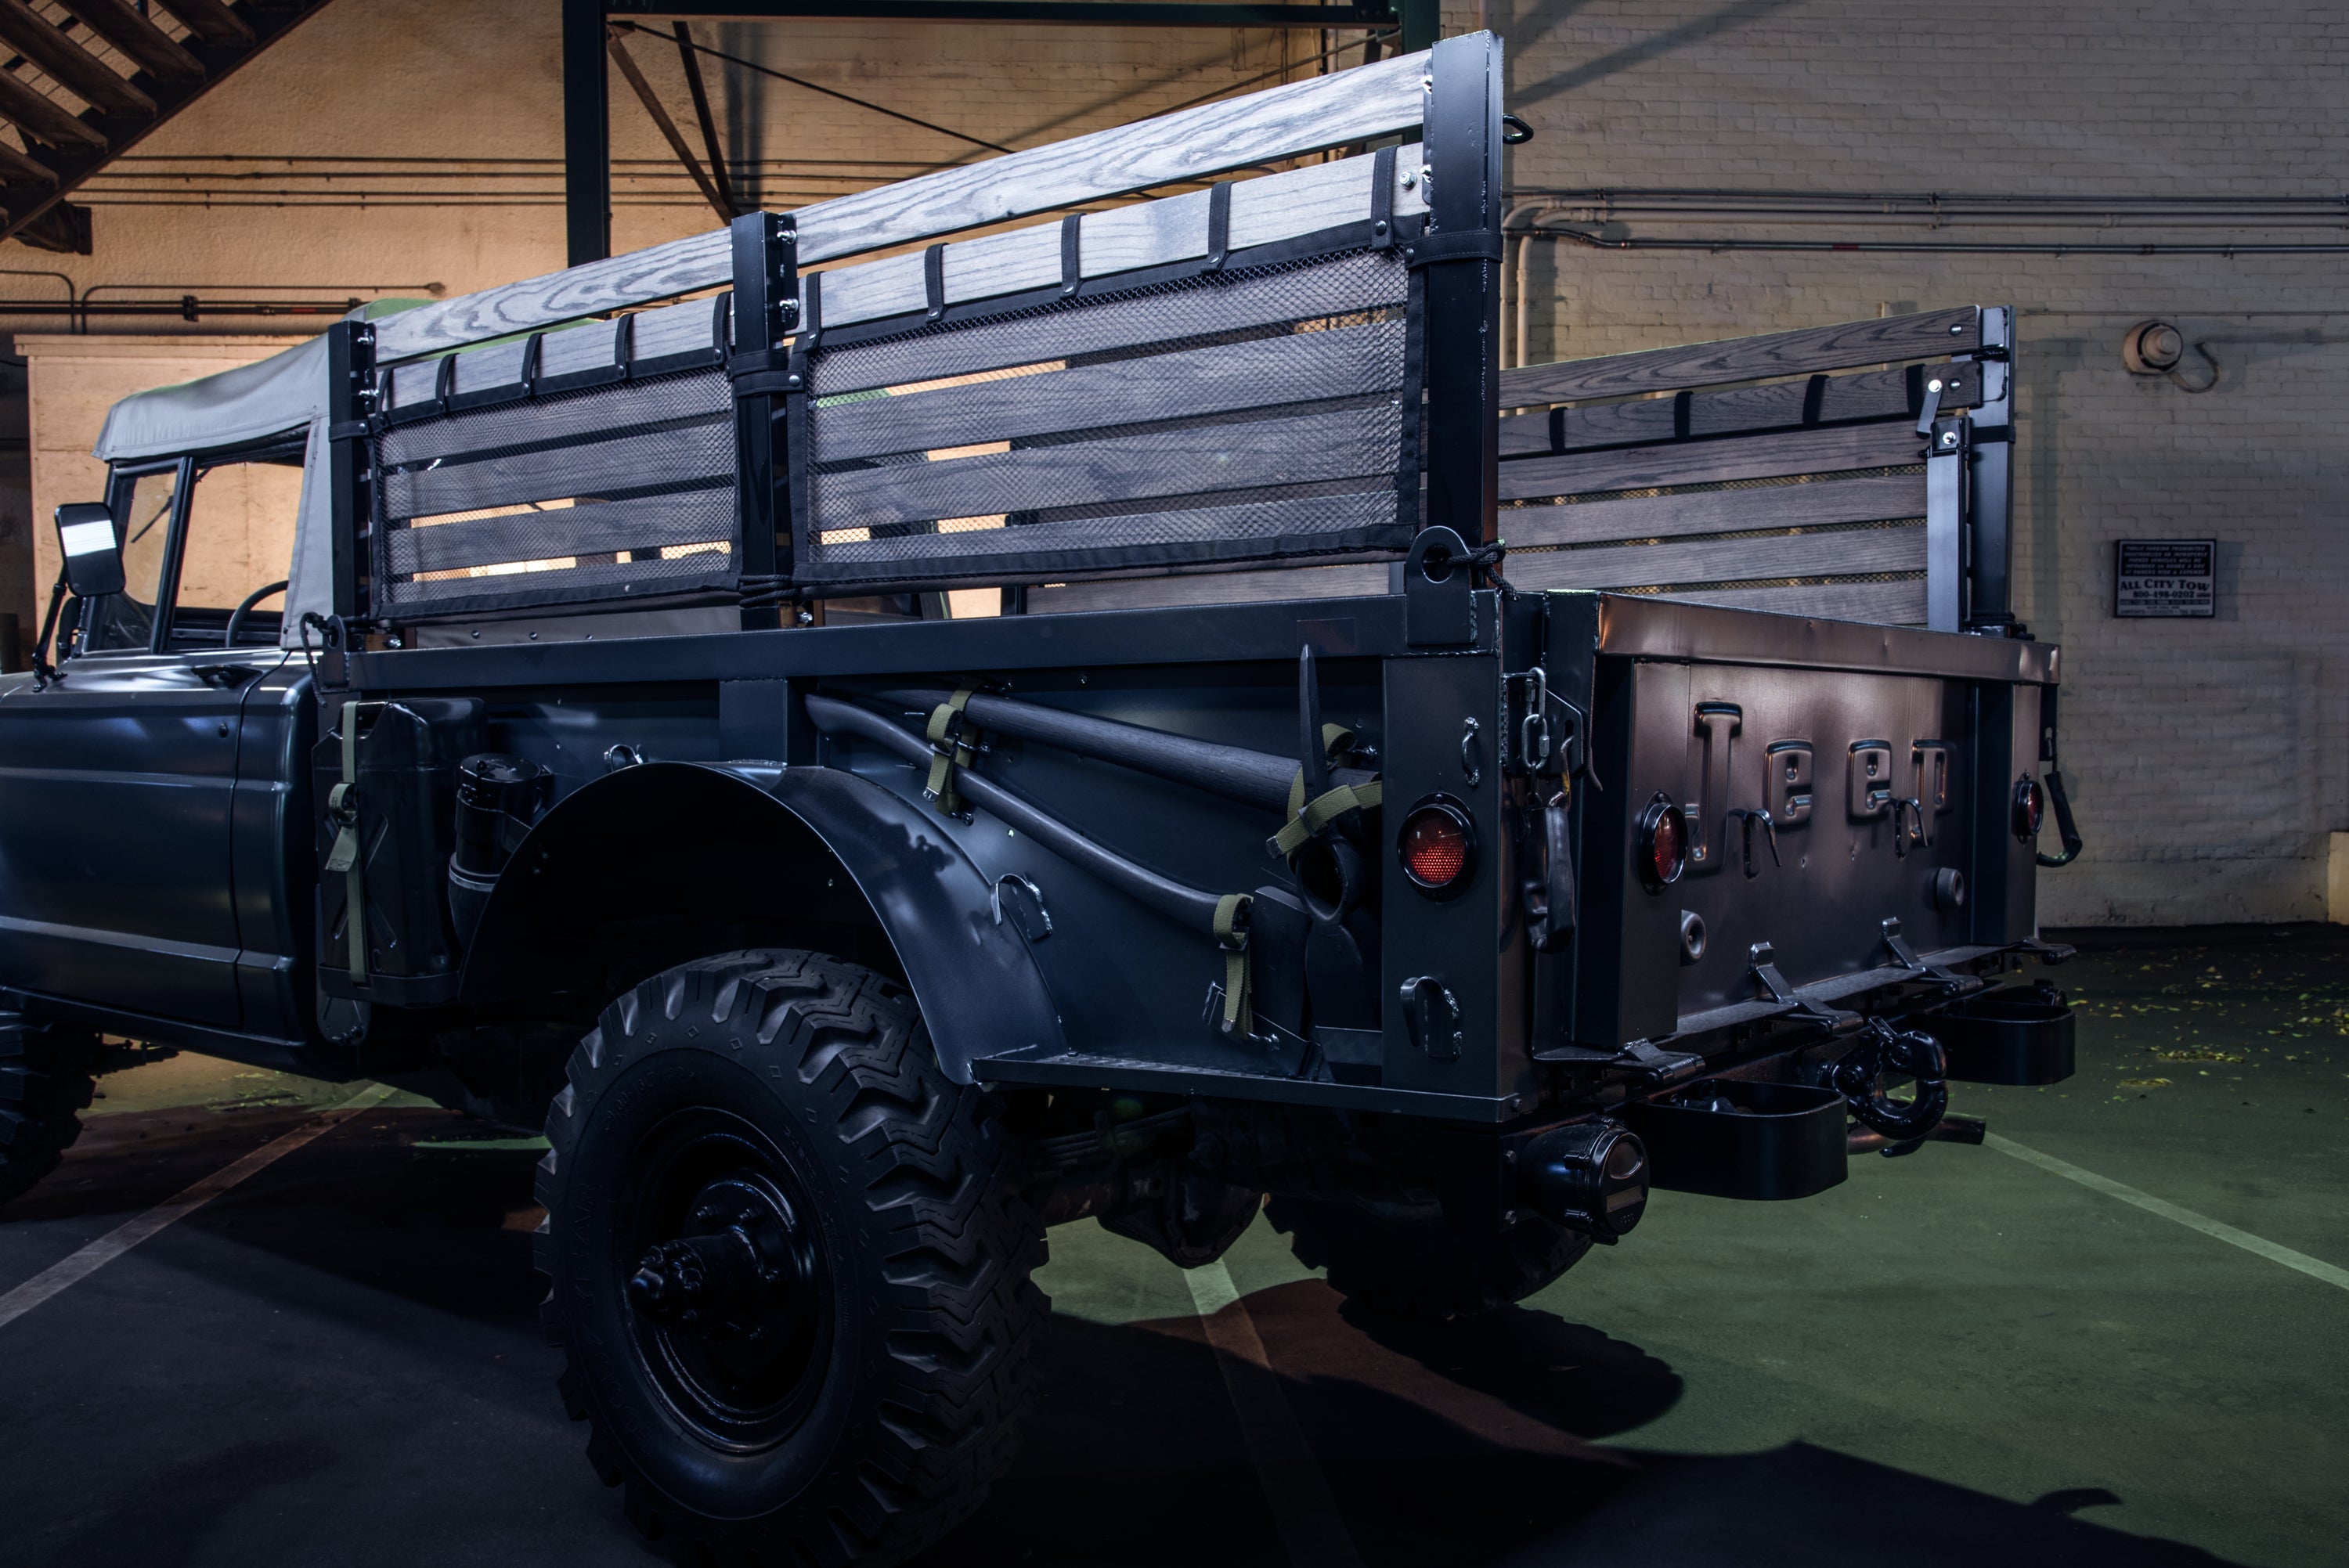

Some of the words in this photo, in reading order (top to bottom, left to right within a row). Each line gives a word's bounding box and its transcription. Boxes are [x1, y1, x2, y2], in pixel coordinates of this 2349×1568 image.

[2120, 580, 2142, 591] ALL
[2144, 579, 2174, 589] CITY
[2178, 579, 2210, 591] TOW
[1683, 701, 1958, 878] Jeep
